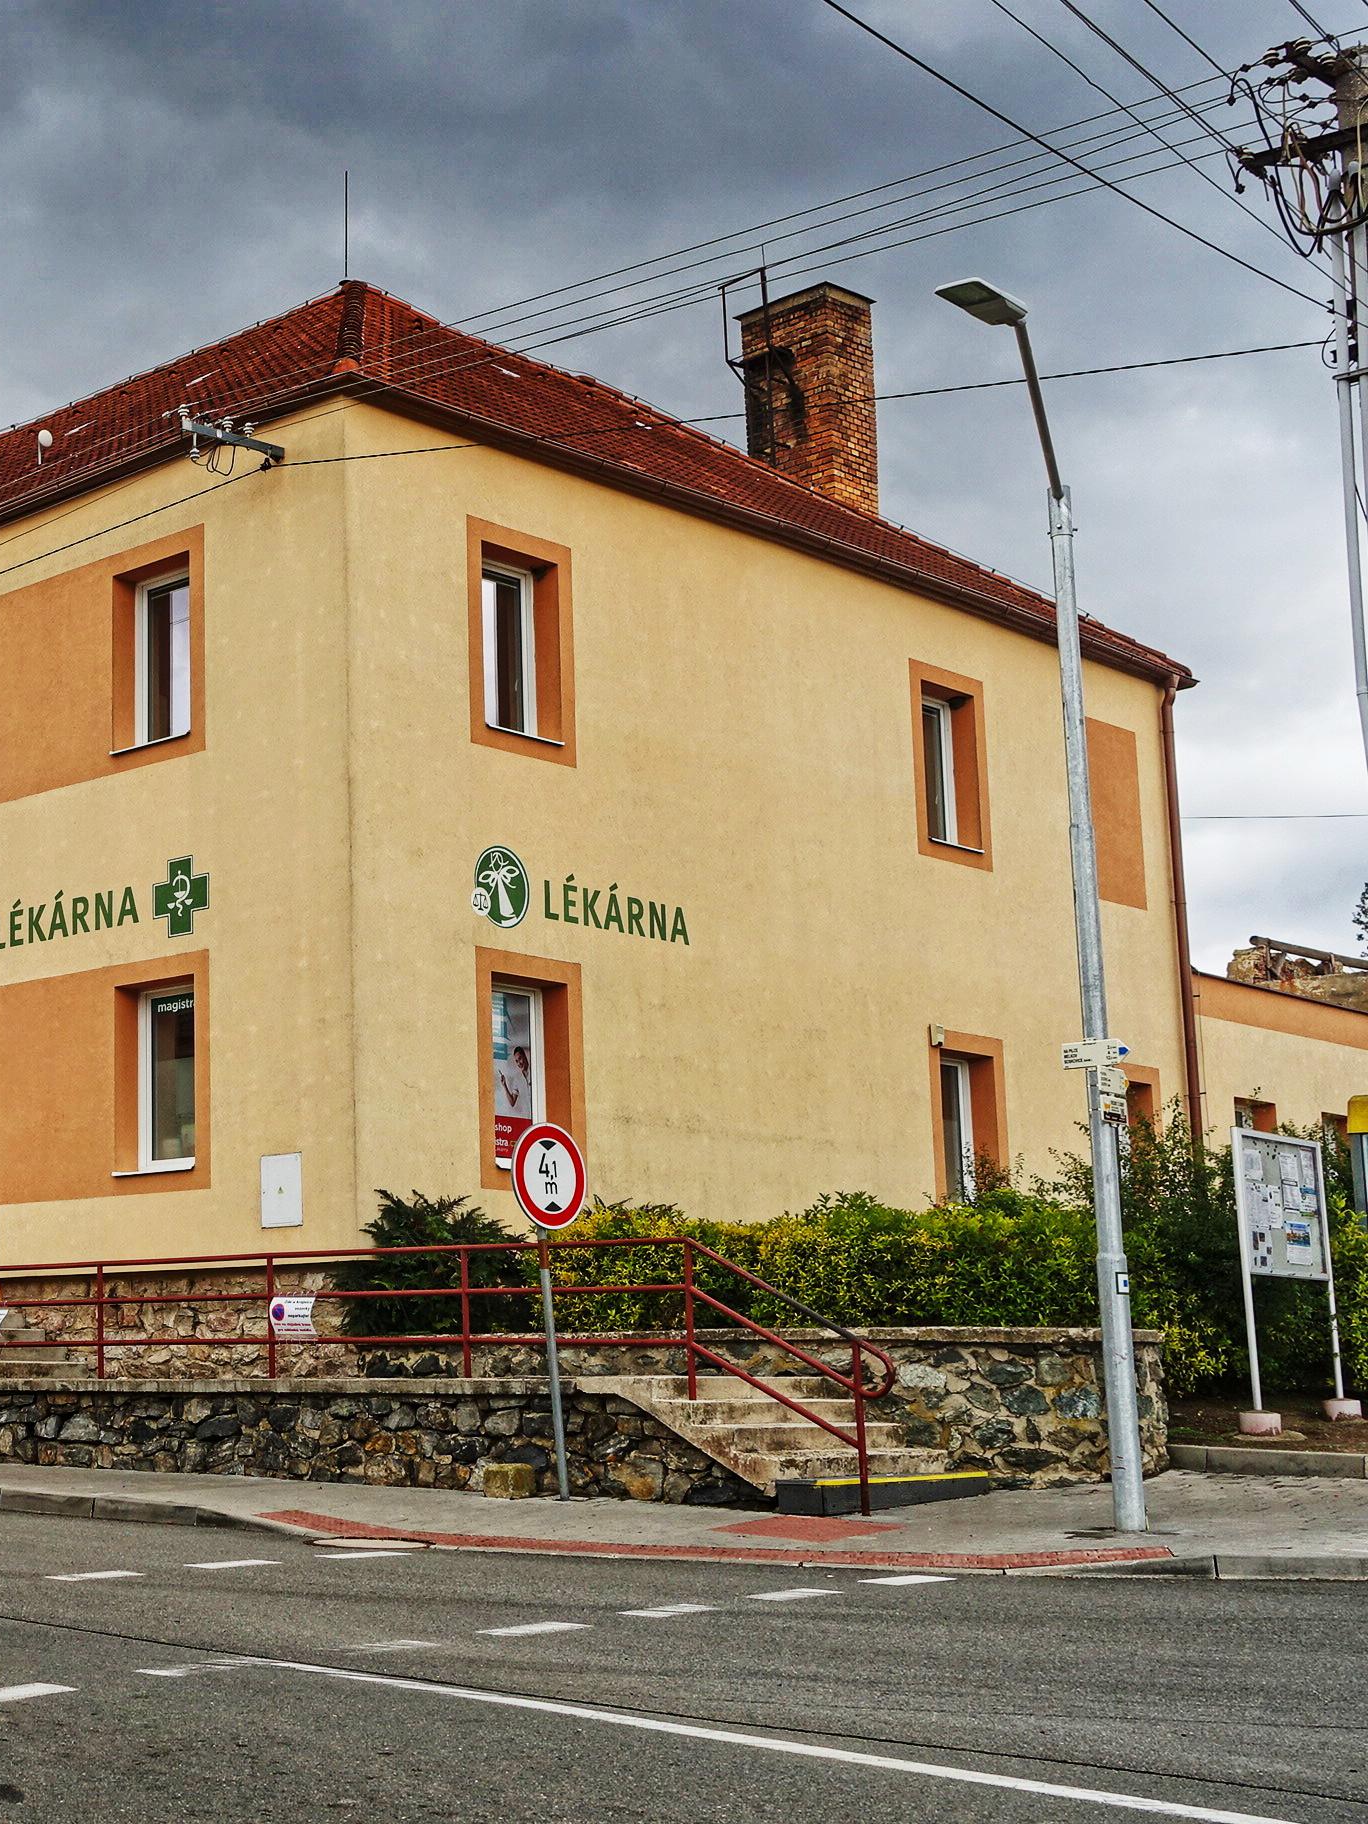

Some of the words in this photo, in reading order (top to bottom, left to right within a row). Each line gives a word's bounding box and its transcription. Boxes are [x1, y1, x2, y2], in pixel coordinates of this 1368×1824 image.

[544, 873, 690, 946] LÉKÁRNA
[157, 998, 194, 1013] magistr
[495, 1138, 509, 1147] stra
[539, 1153, 558, 1180] 4,1
[544, 1181, 558, 1194] m
